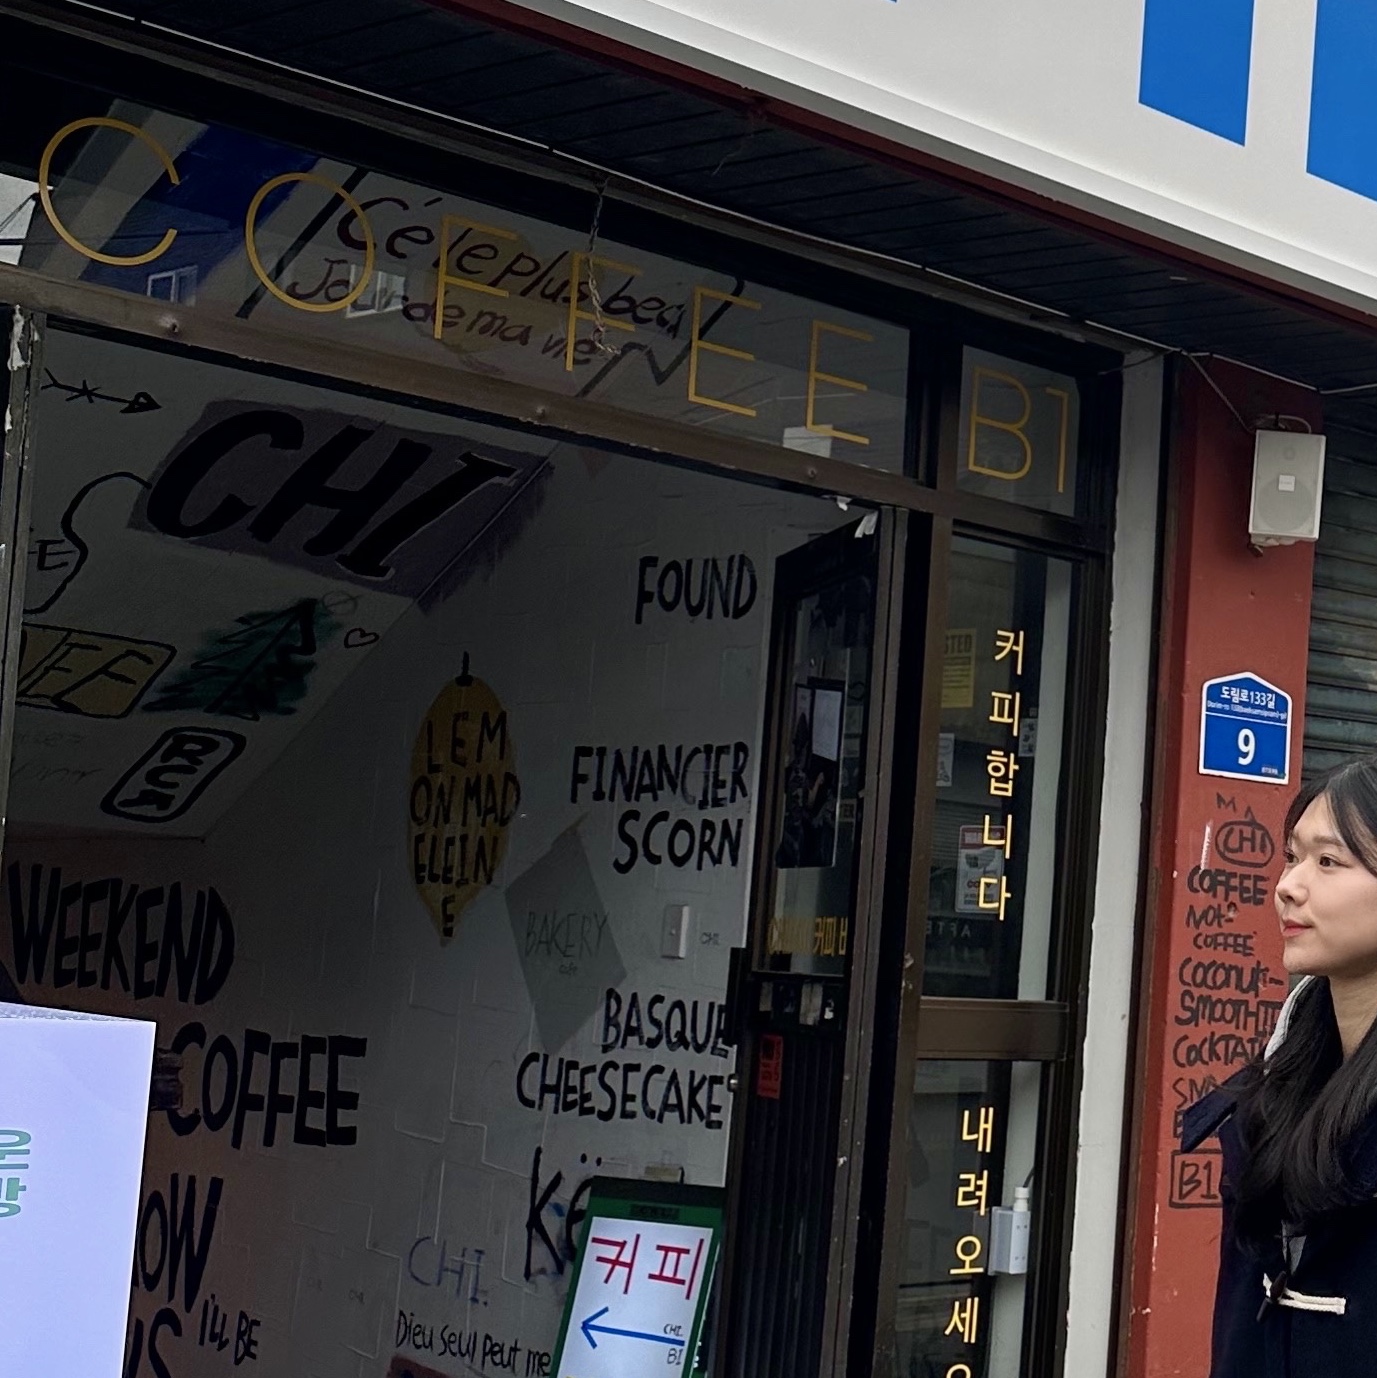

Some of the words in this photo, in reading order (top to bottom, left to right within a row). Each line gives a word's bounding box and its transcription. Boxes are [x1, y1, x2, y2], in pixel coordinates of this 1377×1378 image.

[967, 366, 1070, 494] B1
[146, 408, 519, 581] CHI
[635, 554, 757, 625] FOUND
[1220, 686, 1276, 710] 도림로133길
[426, 711, 508, 774] LEM
[570, 741, 749, 810] FINANCIER
[976, 629, 1026, 922] 커피합니다
[1237, 728, 1256, 766] 9
[613, 809, 744, 875] SCORN
[1222, 827, 1268, 854] CHI
[1187, 864, 1270, 906] COFFEE
[7, 861, 236, 1005] WEEKEND
[525, 911, 609, 959] BAKERY
[1193, 931, 1256, 957] COFFEE
[166, 1022, 369, 1150] COFFEE
[516, 1052, 725, 1129] CHEESECAKE
[1179, 1159, 1219, 1200] B1
[132, 1172, 224, 1313] OW
[591, 1232, 705, 1301] 커피
[234, 1310, 261, 1366] BE
[396, 1310, 433, 1351] Dieu
